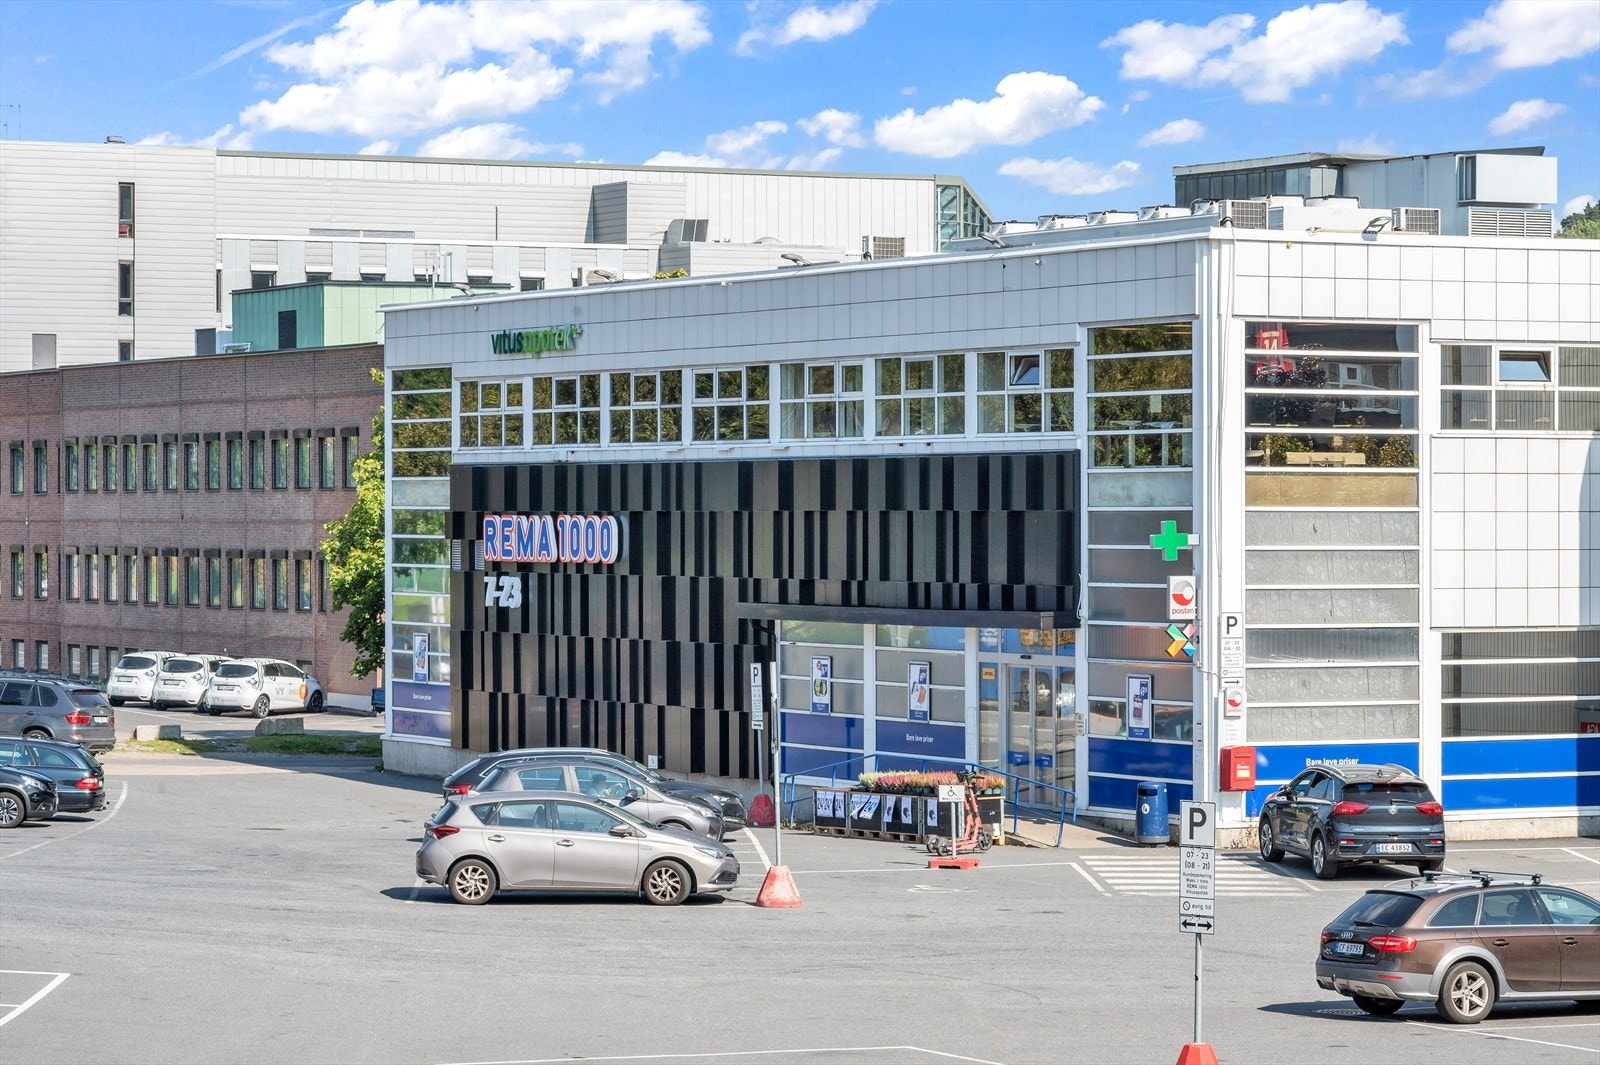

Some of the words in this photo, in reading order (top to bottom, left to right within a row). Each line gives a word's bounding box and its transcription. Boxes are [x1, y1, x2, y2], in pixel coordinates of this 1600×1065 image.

[483, 514, 557, 563] REMA
[556, 514, 618, 564] 1000
[483, 576, 522, 608] 7-23
[1171, 607, 1195, 615] posten
[1226, 615, 1238, 635] P
[753, 666, 759, 684] P
[1189, 807, 1207, 840] P
[1381, 844, 1389, 852] EC
[1390, 844, 1410, 852] 43852
[1186, 851, 1194, 859] 07
[1201, 852, 1209, 860] 23
[1184, 860, 1196, 869] (08
[1202, 861, 1211, 870] 21)
[1339, 943, 1345, 951] CF
